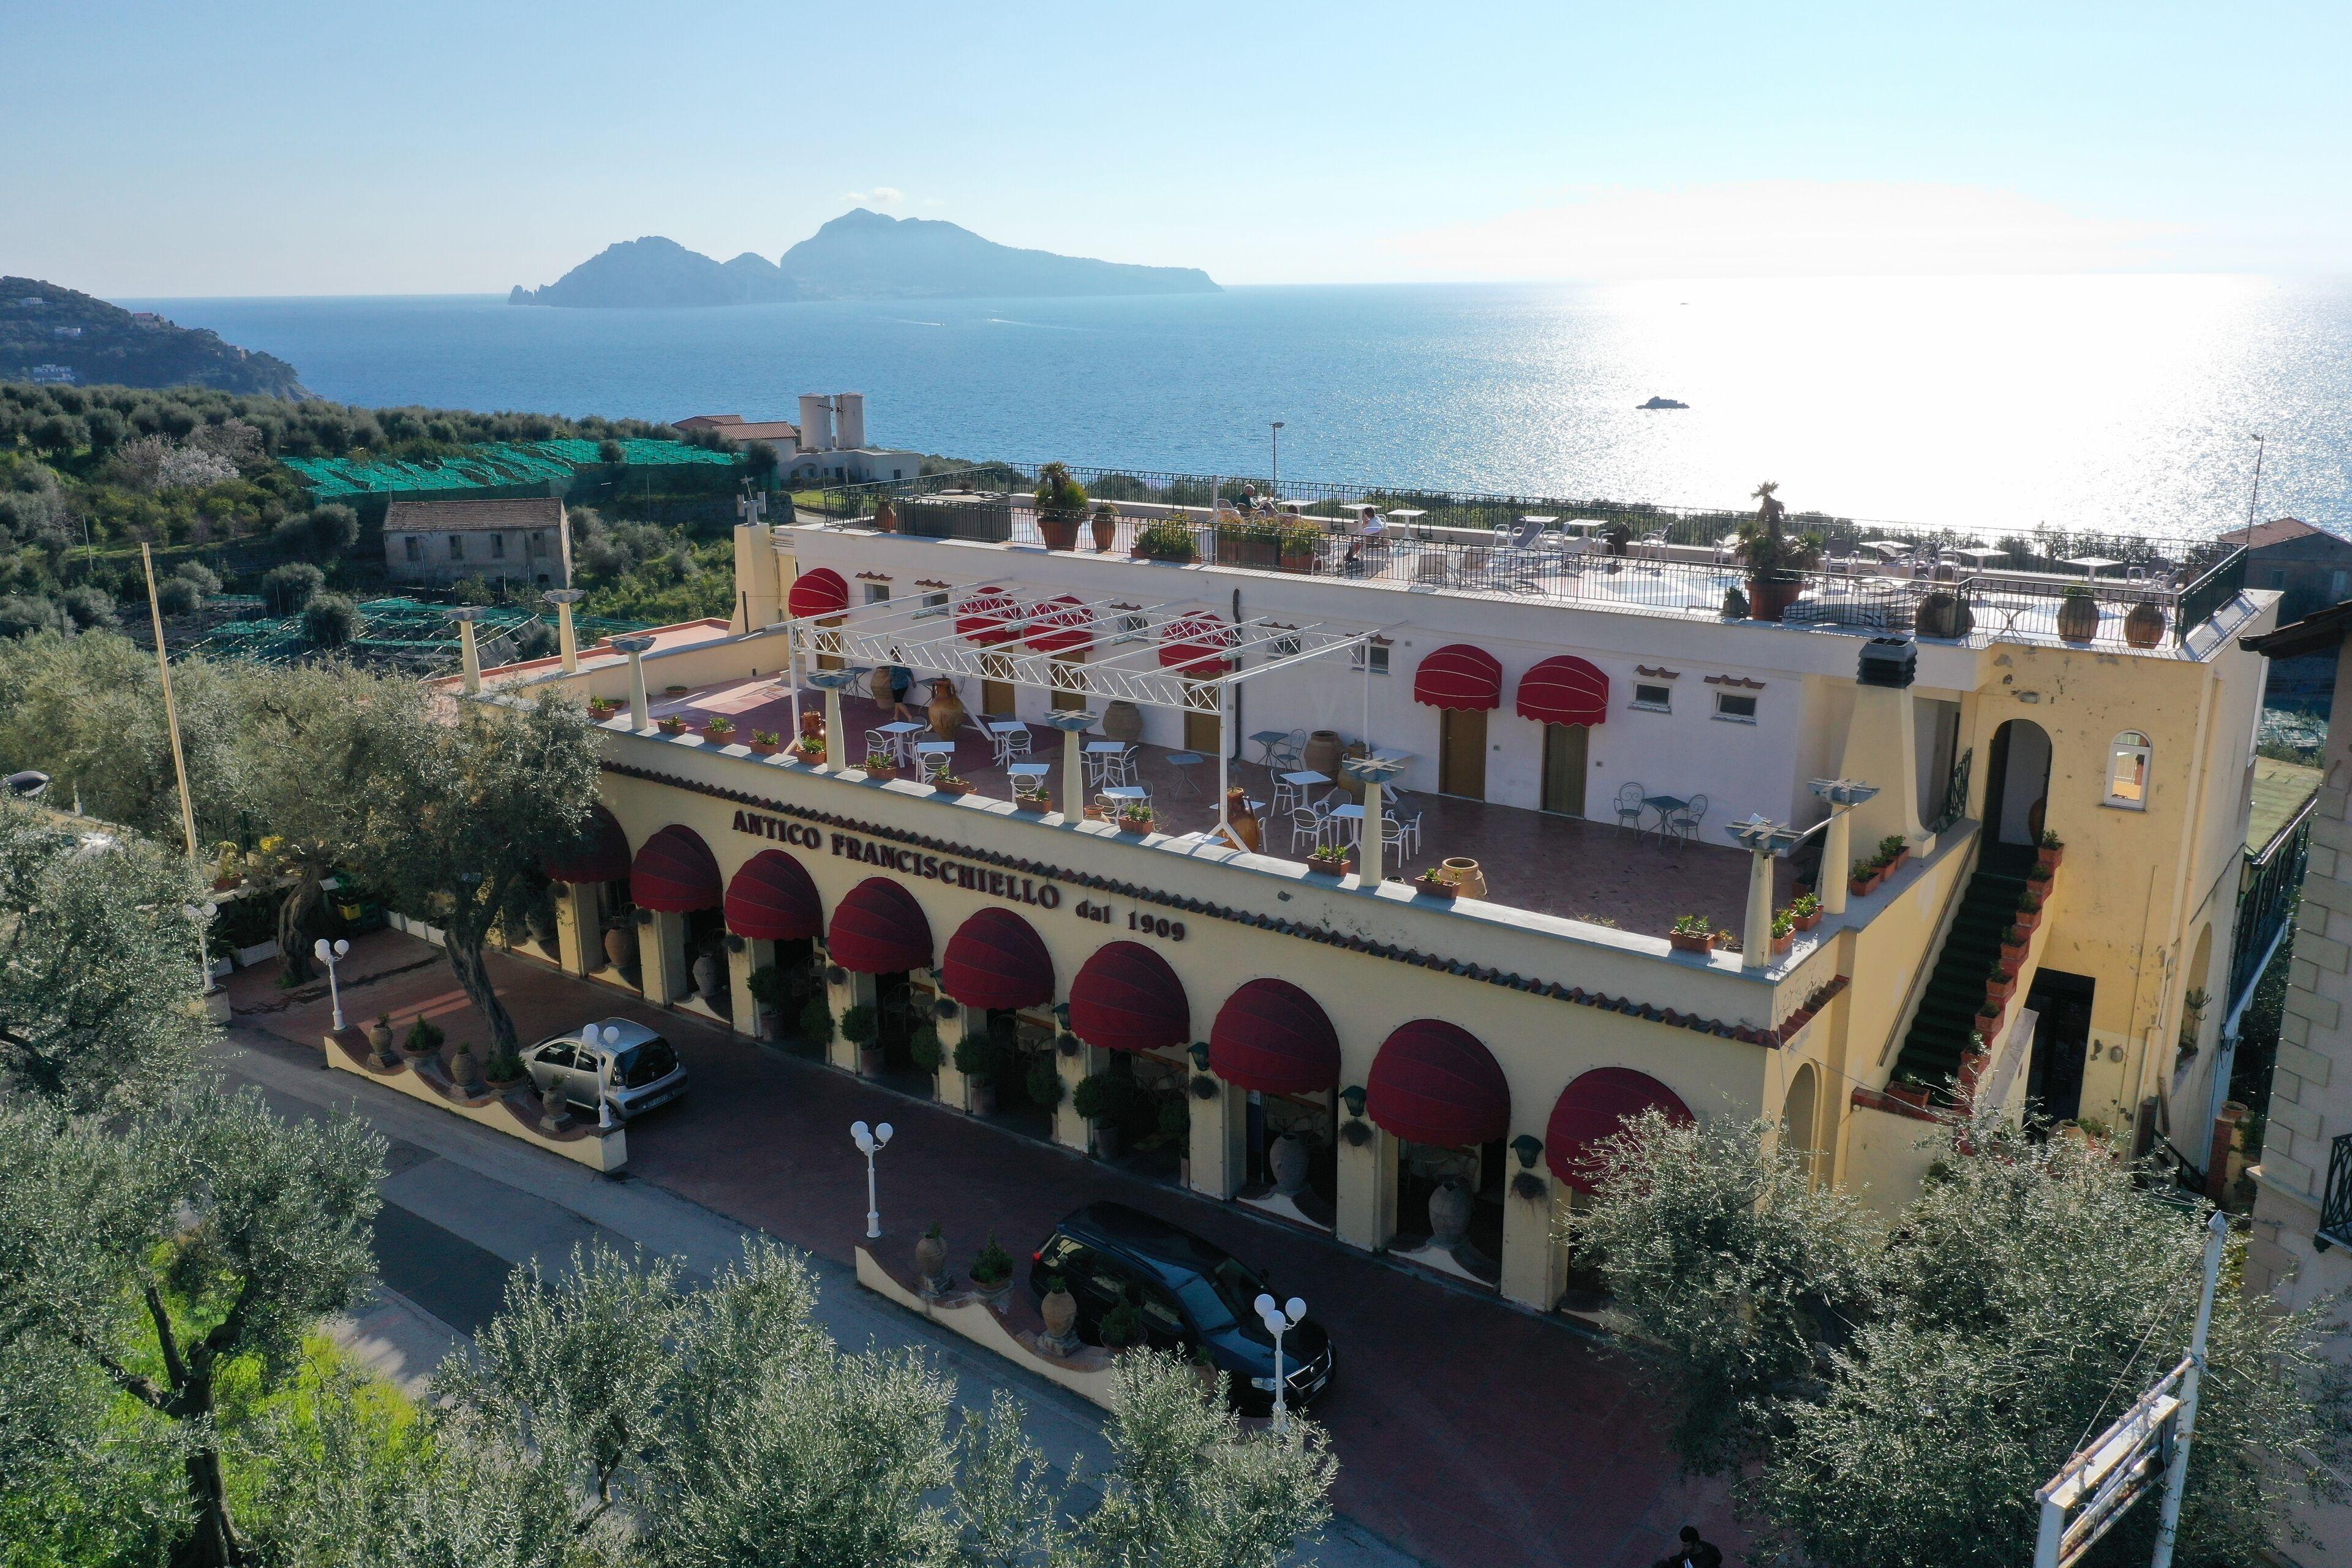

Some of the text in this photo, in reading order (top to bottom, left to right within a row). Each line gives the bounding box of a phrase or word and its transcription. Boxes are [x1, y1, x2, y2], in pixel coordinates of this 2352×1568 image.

[732, 809, 1185, 941] ANTICO FRANCISCHIELLO dal 1909
